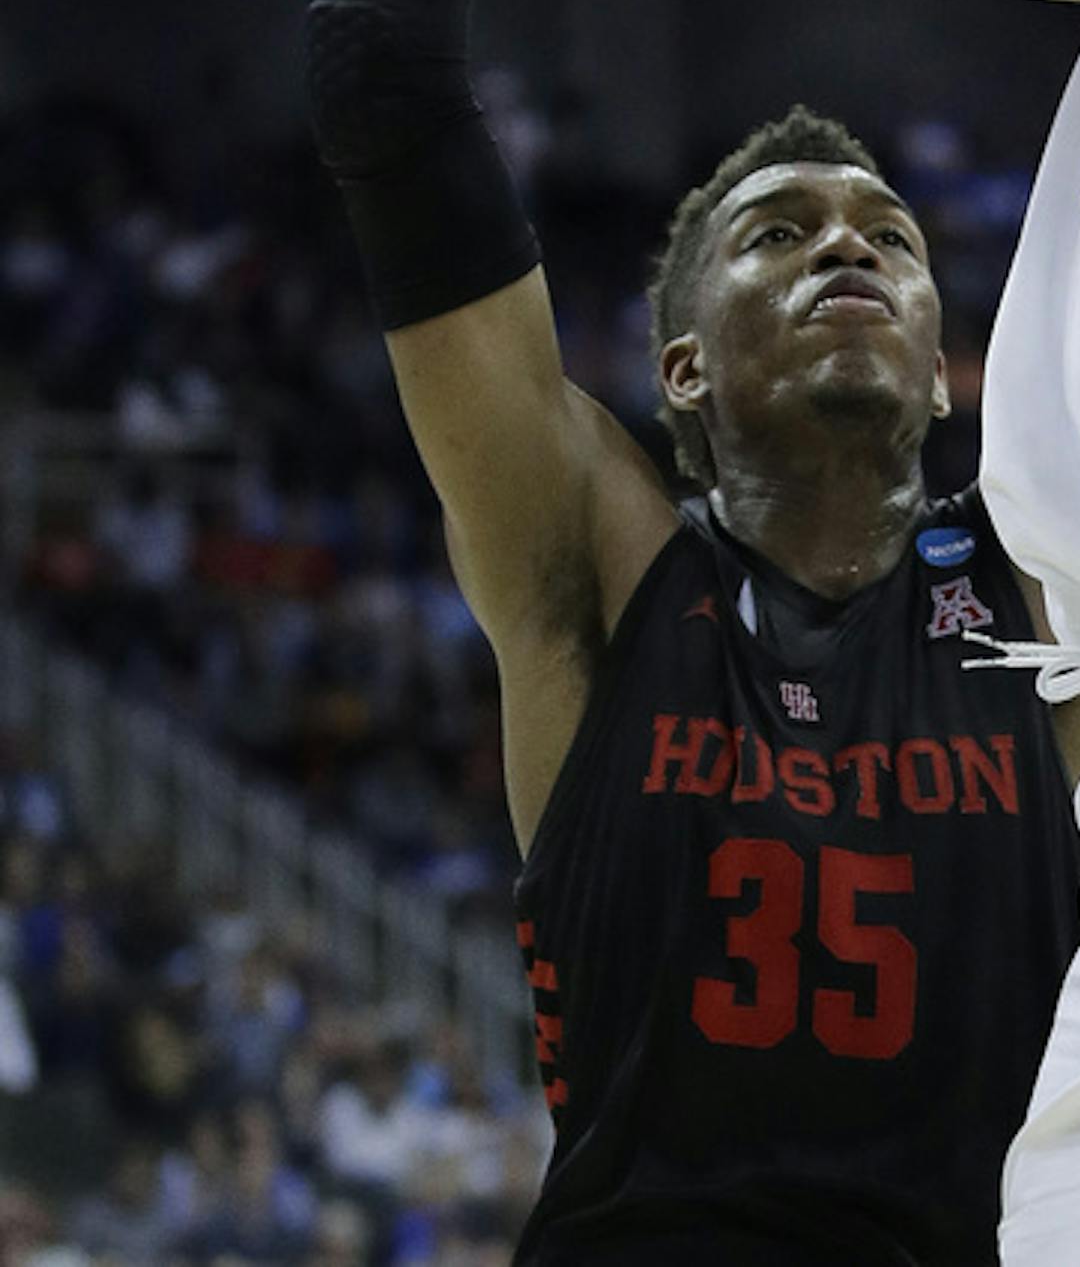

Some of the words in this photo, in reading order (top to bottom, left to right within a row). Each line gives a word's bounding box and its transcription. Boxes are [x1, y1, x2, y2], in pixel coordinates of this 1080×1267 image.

[925, 536, 976, 558] NCAA
[641, 712, 1021, 820] HOUSTON
[691, 837, 918, 1061] 35
